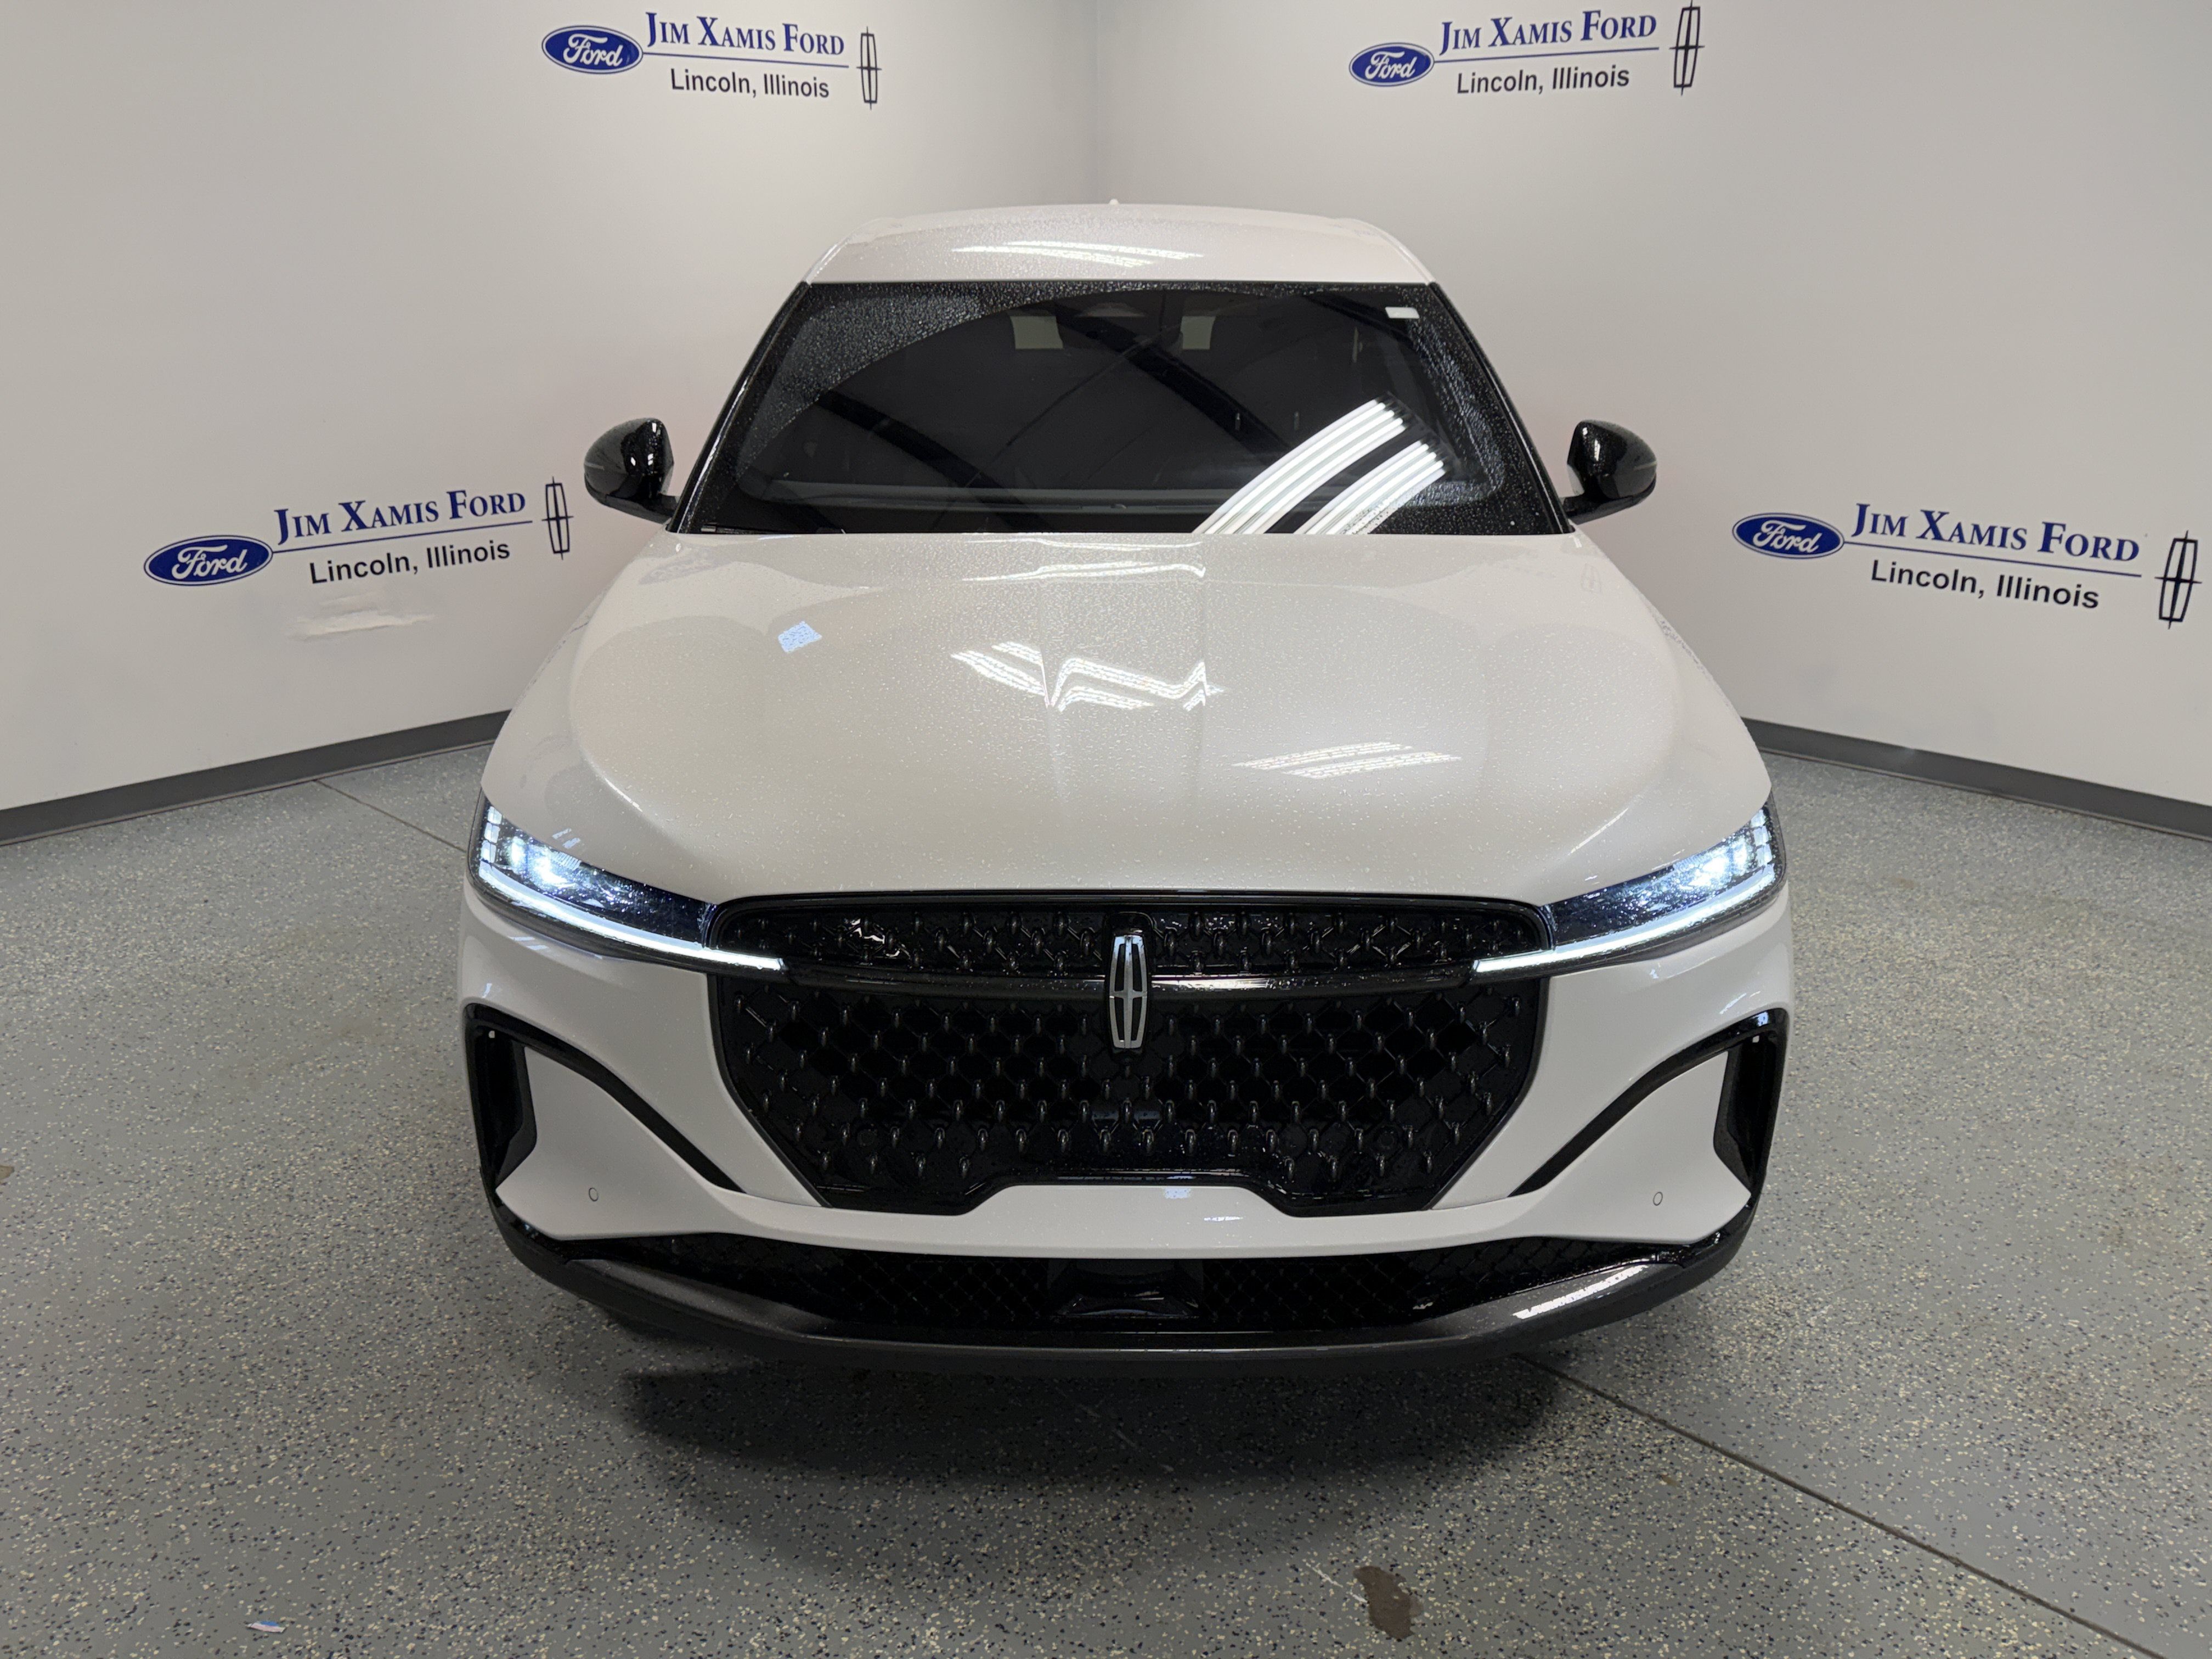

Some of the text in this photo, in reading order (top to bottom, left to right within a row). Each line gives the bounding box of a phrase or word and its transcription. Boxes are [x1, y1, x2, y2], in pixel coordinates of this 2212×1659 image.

[563, 33, 623, 67] Ford
[645, 12, 844, 55] JIM XAMIS FORD
[1439, 10, 1657, 56] JIM XAMIS FORD
[670, 68, 830, 98] Lincoln, Illinois
[1364, 51, 1418, 79] Ford
[1457, 64, 1629, 95] Lincoln, Illinois
[274, 489, 526, 545] JIM XAMIS FORD
[1752, 520, 1820, 553] Ford
[1851, 503, 2140, 561] JIM XAMIS FORD
[171, 544, 248, 579] Ford
[309, 540, 510, 584] Lincoln, Illinois
[1871, 560, 2099, 609] Lincoln, Illinois
